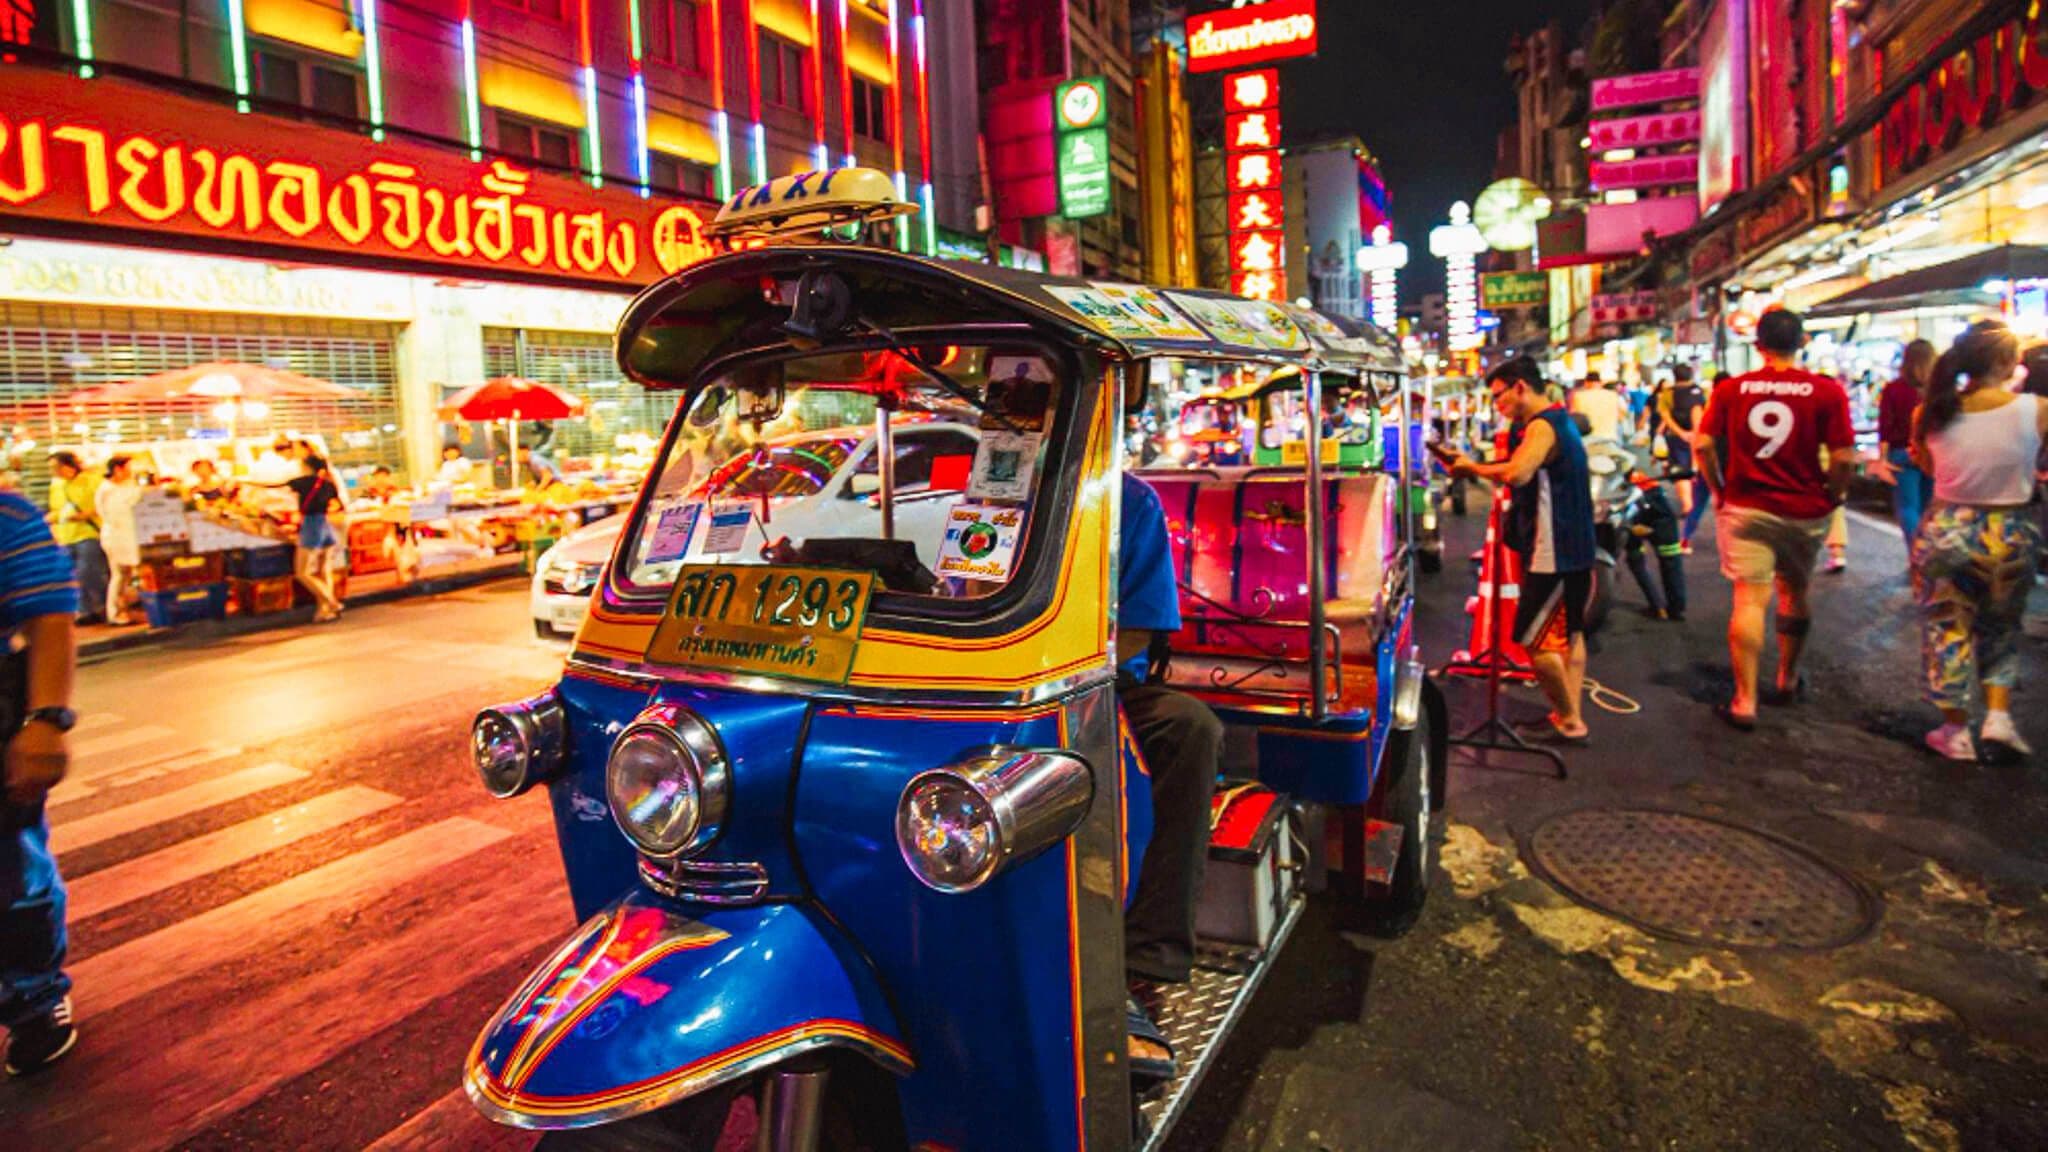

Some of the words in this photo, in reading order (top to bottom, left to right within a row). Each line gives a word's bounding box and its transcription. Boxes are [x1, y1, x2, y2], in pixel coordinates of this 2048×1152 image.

[731, 167, 842, 212] TAXI
[1740, 380, 1814, 397] FIRMINO
[1748, 400, 1795, 459] 9
[752, 574, 861, 631] 1293
[677, 632, 819, 667] กรุงเทพมหานคร
